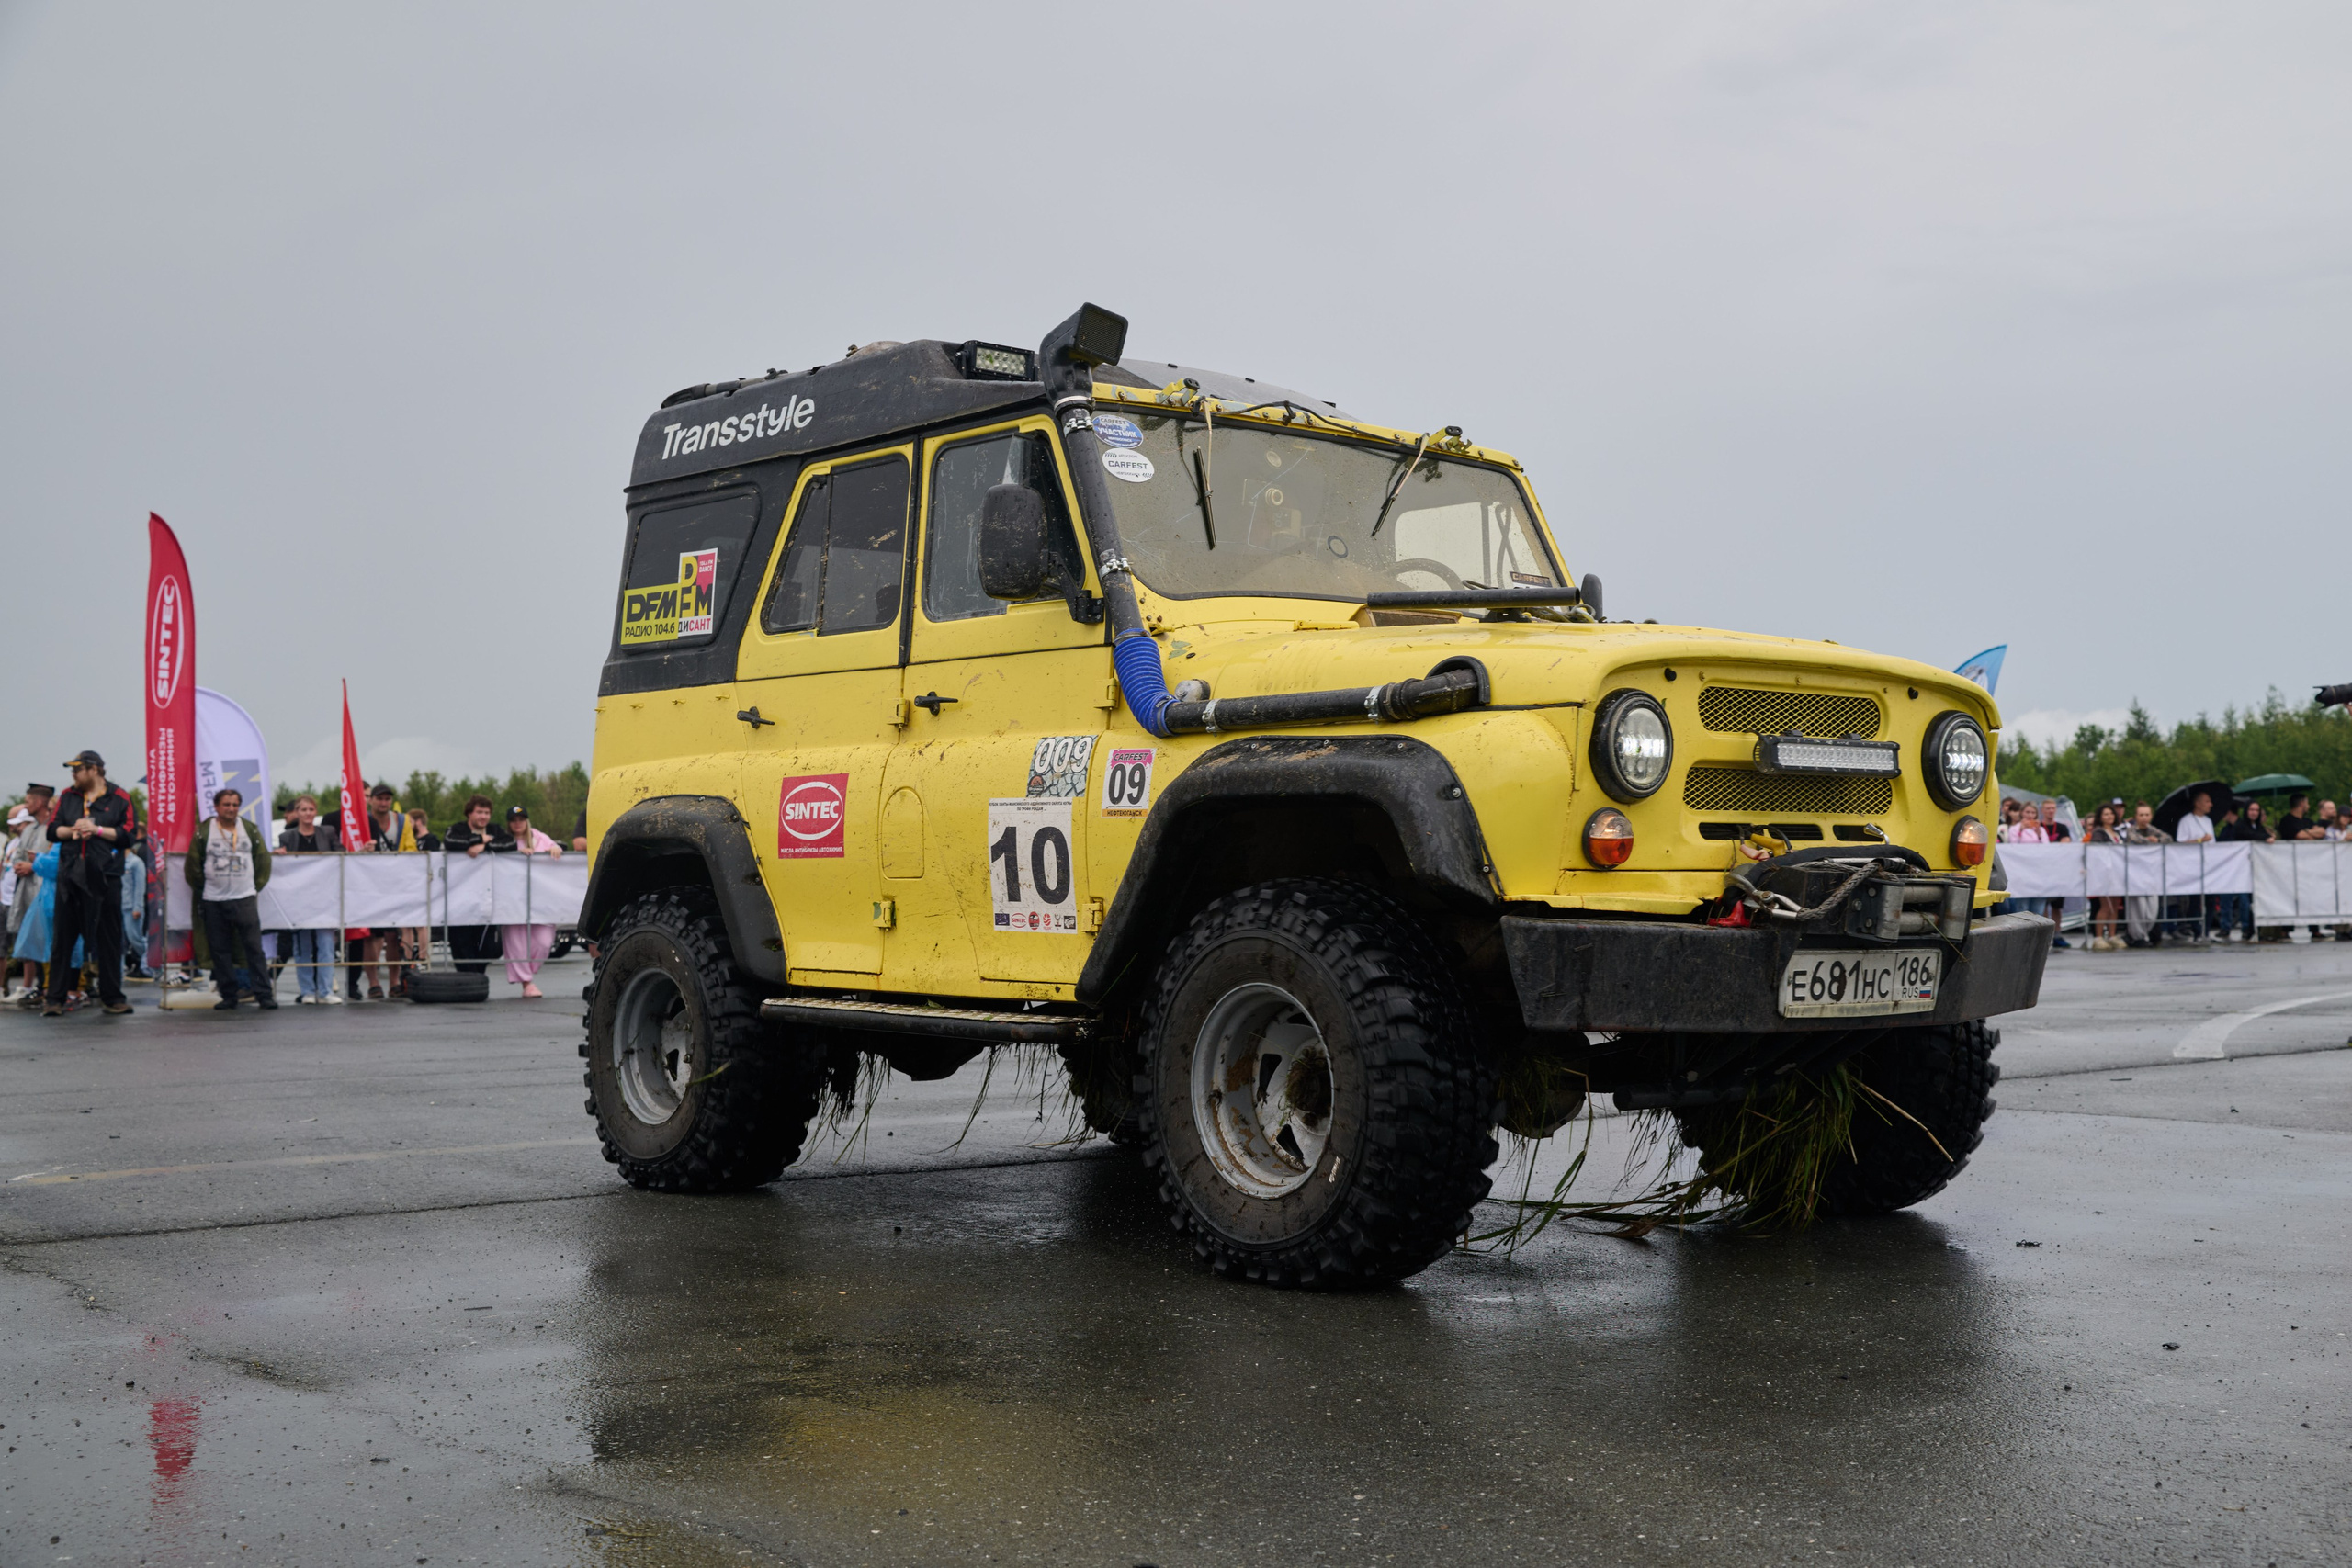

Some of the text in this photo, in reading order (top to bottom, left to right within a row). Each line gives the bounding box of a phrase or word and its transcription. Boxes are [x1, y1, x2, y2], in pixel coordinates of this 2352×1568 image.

[662, 394, 816, 460] Transstyle
[1097, 426, 1138, 438] УЧАСТНИК
[1108, 460, 1148, 470] CARFEST
[698, 564, 713, 573] DANCE
[1512, 572, 1550, 585] CARFEST
[626, 590, 678, 623] DFM
[157, 584, 175, 699] SINTEC
[625, 622, 675, 637] РАДИО 104.6
[1034, 736, 1092, 773] 009
[1114, 752, 1149, 761] CARFEST
[157, 727, 167, 824] АНТИФРИЗЫ
[166, 728, 176, 823] АВТОХИМИЯ
[1108, 762, 1147, 806] 09
[785, 800, 840, 820] SINTEC
[991, 826, 1070, 905] 10
[1897, 956, 1931, 987] 186
[1901, 987, 1919, 998] RUS
